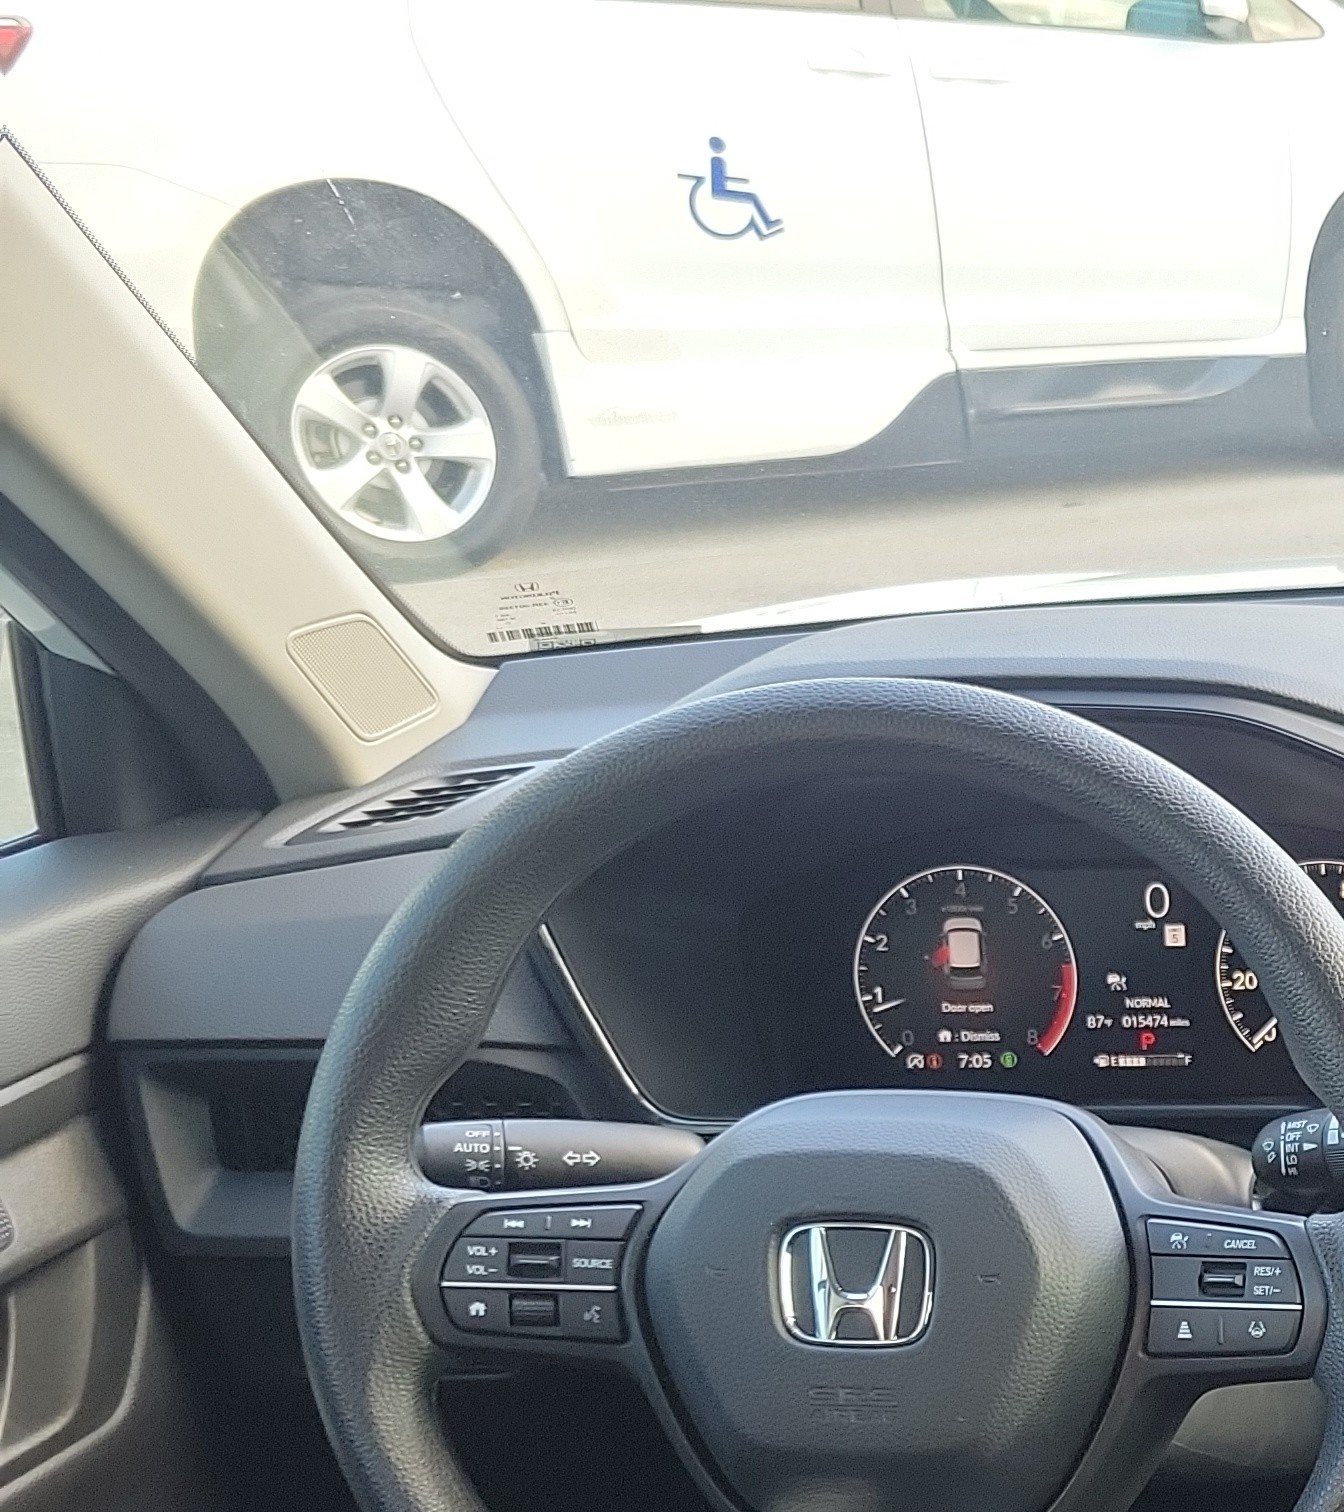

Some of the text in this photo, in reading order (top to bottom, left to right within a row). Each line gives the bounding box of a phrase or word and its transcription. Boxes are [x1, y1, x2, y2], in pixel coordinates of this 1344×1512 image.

[956, 883, 966, 897] 4
[905, 899, 917, 915] 3
[1007, 899, 1018, 914] 5
[1145, 883, 1170, 919] 0
[875, 935, 889, 951] 2
[1041, 934, 1051, 949] 6
[1231, 970, 1258, 990] 20
[874, 987, 883, 1003] 1
[941, 1002, 965, 1013] Door
[1125, 997, 1171, 1009] NORMAL
[1121, 1014, 1168, 1028] 015474
[902, 1030, 914, 1045] 0
[961, 1029, 1000, 1042] Dismiss
[1026, 1029, 1038, 1045] 8
[1140, 1032, 1156, 1050] P
[957, 1054, 993, 1069] 7:05
[465, 1130, 491, 1138] OFF
[1286, 1131, 1303, 1142] OFF
[453, 1142, 491, 1154] AUTO
[1286, 1142, 1300, 1153] INT
[466, 1245, 499, 1257] VOL+
[1224, 1239, 1257, 1250] CANCEL
[572, 1257, 614, 1270] SOURCE
[1253, 1266, 1282, 1277] RES/+
